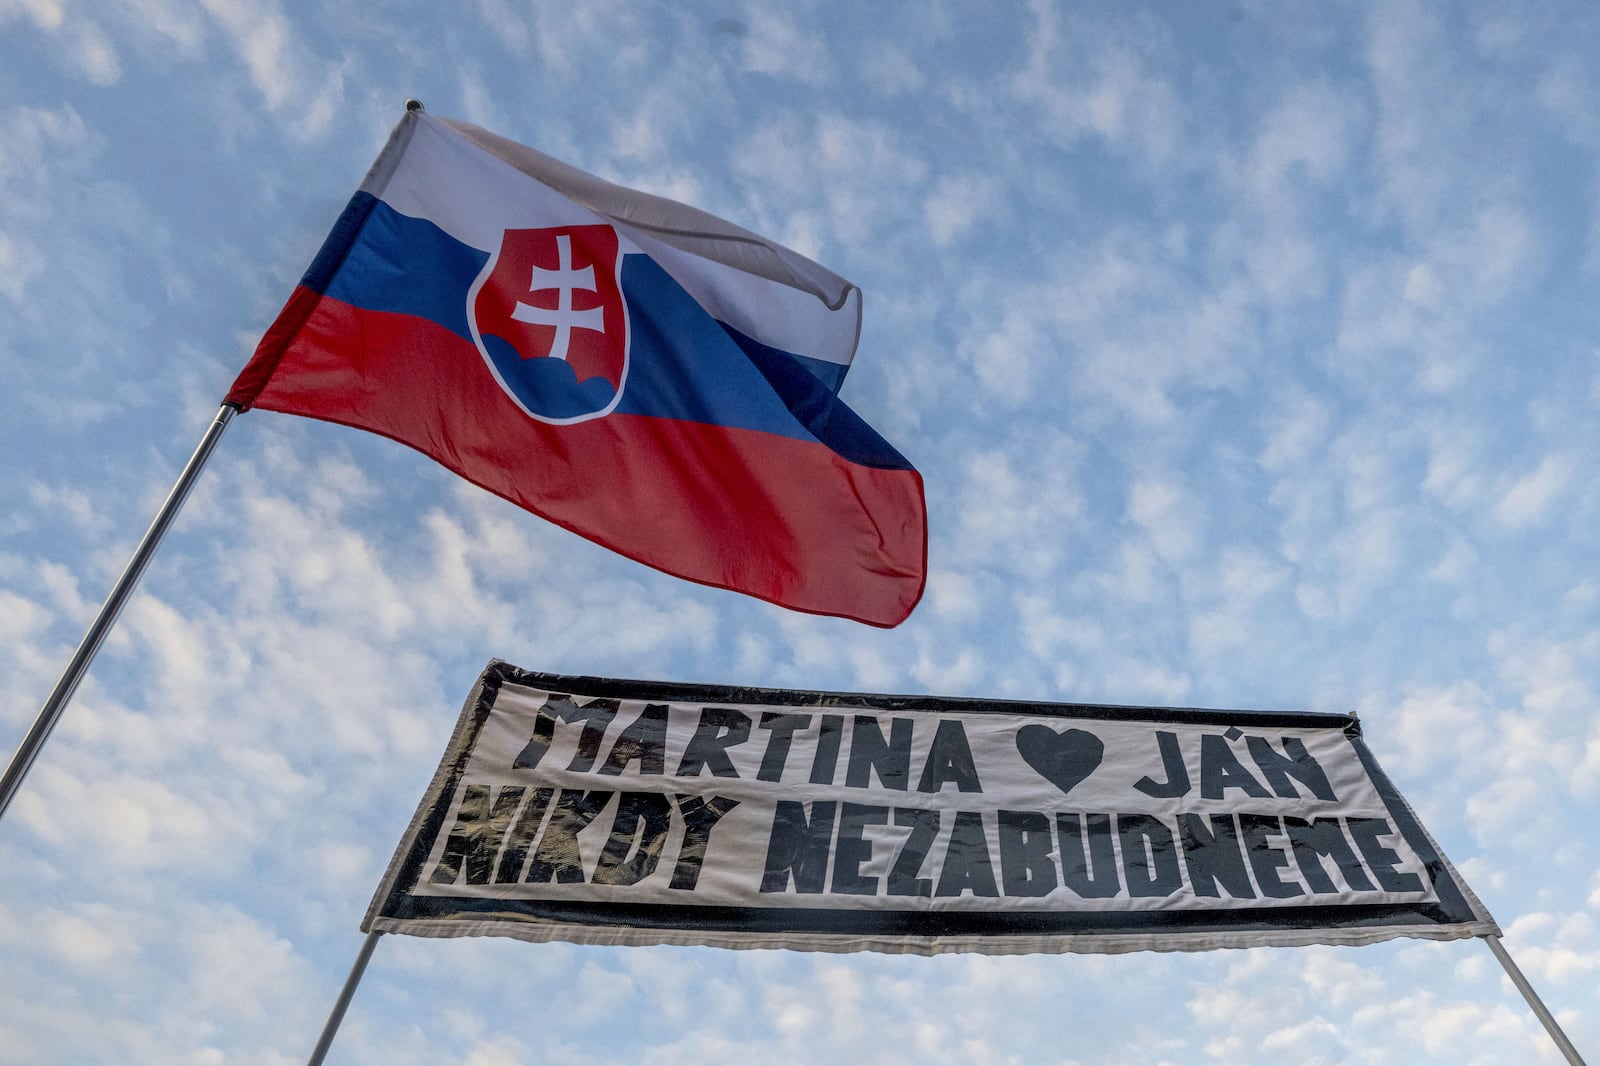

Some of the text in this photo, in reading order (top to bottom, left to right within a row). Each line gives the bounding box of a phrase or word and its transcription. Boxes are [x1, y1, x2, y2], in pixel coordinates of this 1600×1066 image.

[513, 693, 1338, 801] MARTINA JÁN
[428, 784, 1425, 899] NIKDY NEZABUDNEME
